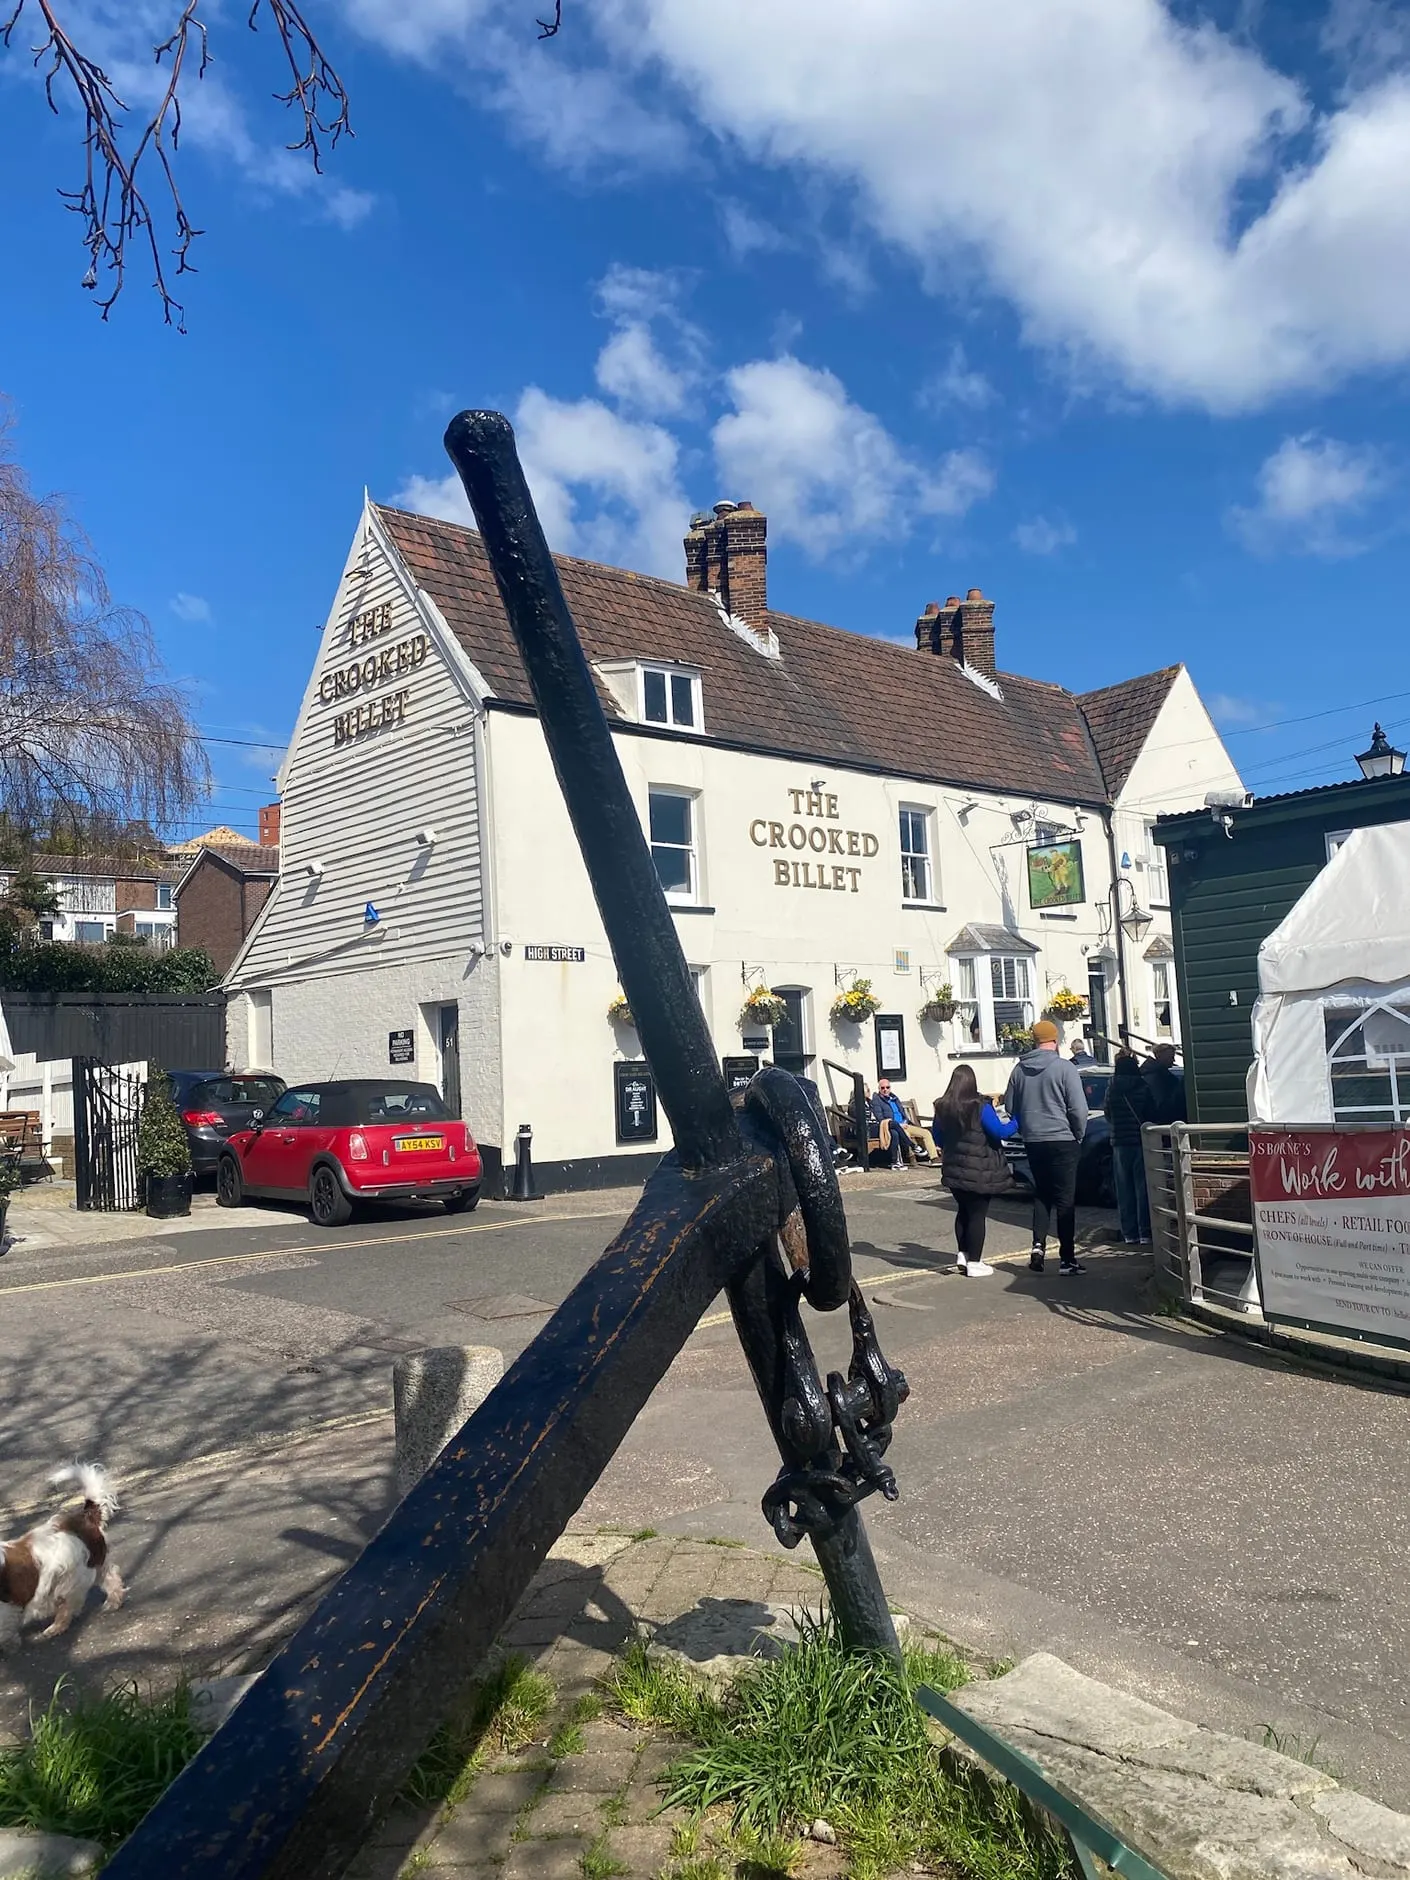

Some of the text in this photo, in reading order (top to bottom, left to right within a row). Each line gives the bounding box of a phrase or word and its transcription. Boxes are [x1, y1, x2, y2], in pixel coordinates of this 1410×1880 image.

[350, 602, 393, 646] THE
[320, 634, 430, 702] CROOKED
[334, 689, 410, 745] BILLET
[787, 788, 840, 819] THE
[749, 819, 880, 857] CROOKED
[773, 859, 862, 892] BILLET
[528, 947, 583, 960] HIGH STREET
[445, 1037, 453, 1048] 51
[401, 1139, 441, 1150] AY54 KSV
[1280, 1138, 1410, 1196] Work with
[1259, 1210, 1296, 1225] CHEFS
[1342, 1215, 1384, 1232] RETAIL
[1263, 1230, 1292, 1241] FRONT
[1304, 1233, 1333, 1246] HOUSE
